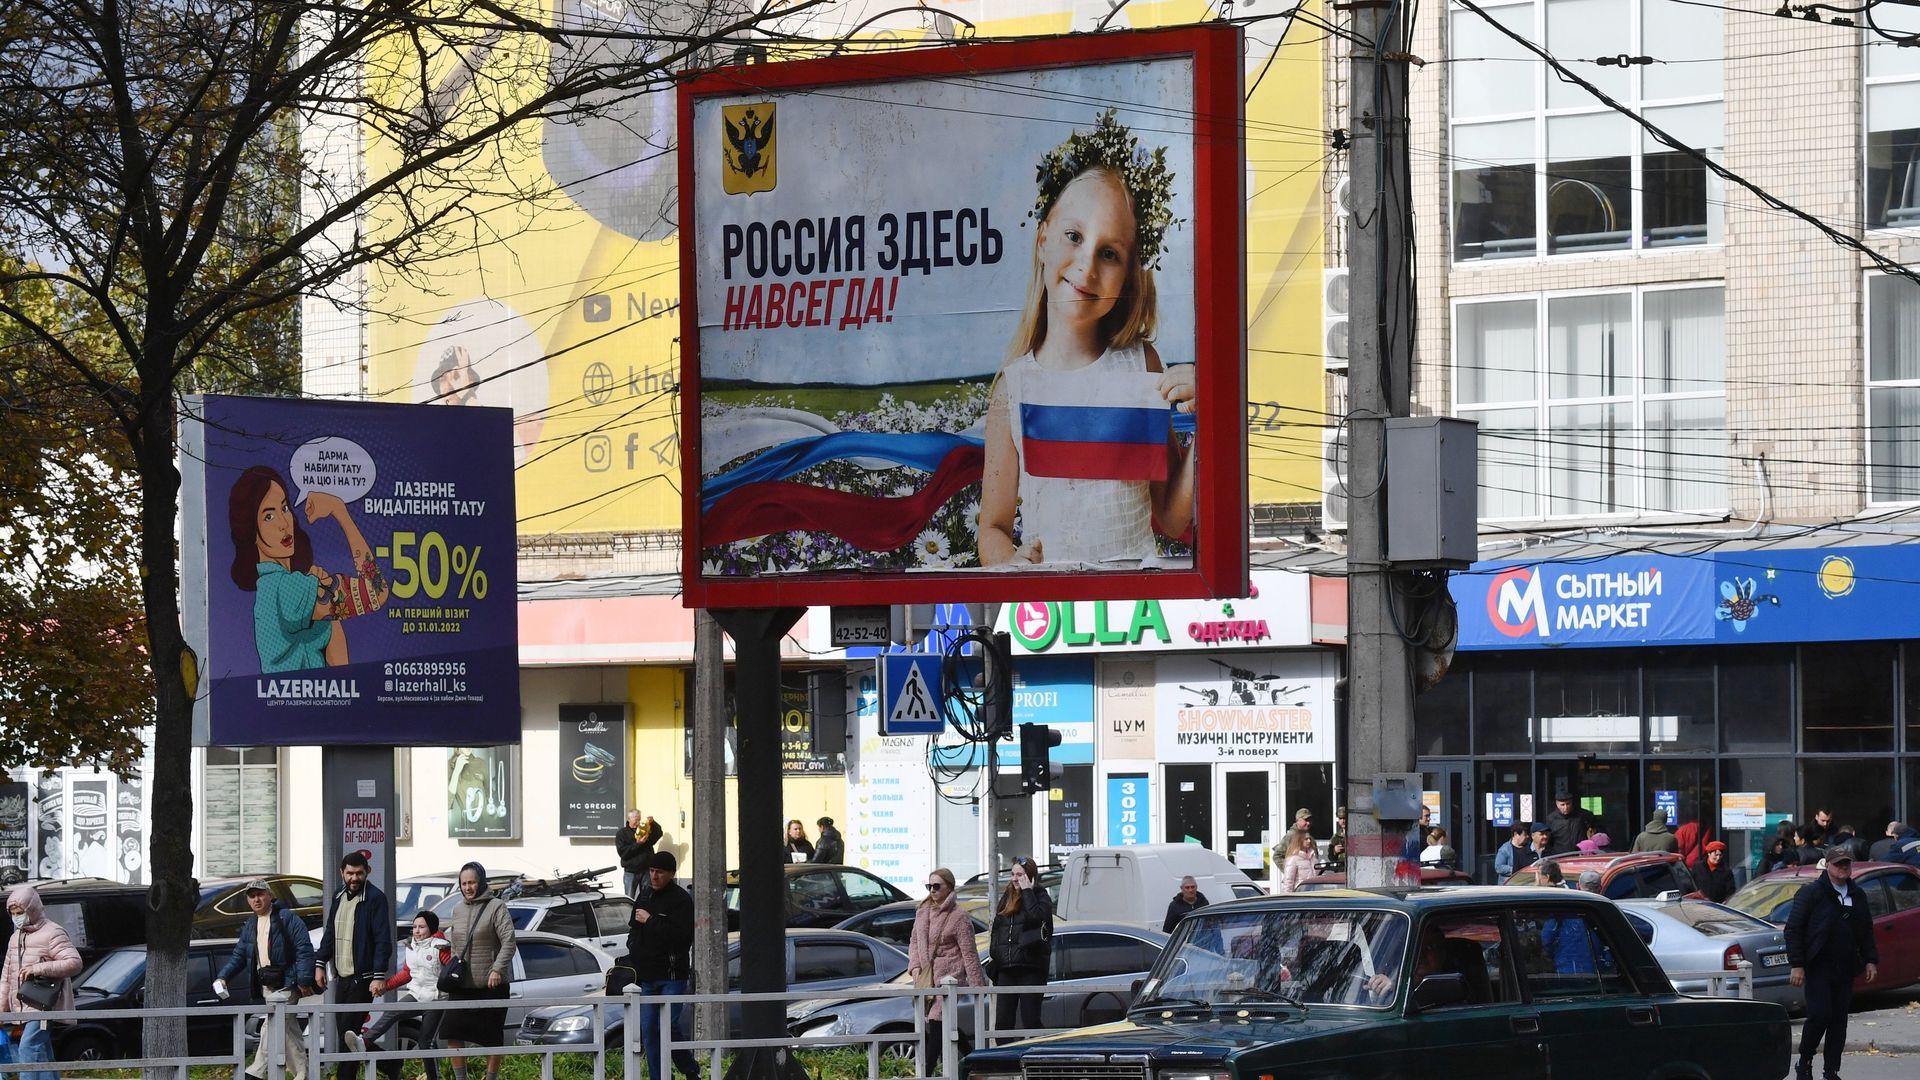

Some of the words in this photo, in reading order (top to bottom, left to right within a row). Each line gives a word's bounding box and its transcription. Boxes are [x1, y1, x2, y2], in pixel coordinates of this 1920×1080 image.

[723, 215, 865, 280] РОССИЯ
[877, 207, 1003, 276] ЗДЕСЬ
[723, 276, 899, 331] НАВСЕГДА!
[318, 451, 349, 461] ДАРМА
[304, 463, 340, 473] НАБИЛИ
[341, 464, 361, 474] ТАТУ
[303, 475, 315, 485] НА
[317, 476, 332, 486] ЦЮ
[338, 477, 350, 486] НА
[351, 477, 366, 487] ТУ?
[394, 481, 456, 498] ЛАЗЕРНЕ
[364, 499, 449, 517] ВИДАЛЕННЯ
[452, 501, 486, 516] ТАТУ
[376, 531, 488, 600] -50%
[1556, 567, 1662, 599] СЫТНЫЙ
[388, 608, 402, 618] НА
[405, 606, 442, 618] ПЕРШИЙ
[445, 608, 470, 618] ВІЗИТ
[1556, 602, 1652, 630] МАРКЕТ
[402, 623, 416, 633] ДО
[418, 622, 461, 632] 31.01.2022
[836, 627, 887, 640] 42-52-40
[1188, 620, 1271, 644] ОДЕЖДА
[394, 662, 467, 676] 0663895956
[257, 679, 360, 698] LAZERHALL
[395, 678, 467, 693] lazerhall_ks
[1014, 691, 1058, 707] PROFI
[1113, 720, 1145, 734] ЦУМ
[1177, 709, 1313, 732] SHOWMASTER
[882, 737, 916, 747] MAGNAT
[1177, 732, 1228, 745] МУЗИЧНІ
[1231, 731, 1313, 744] ІНСТРУМЕНТИ
[1217, 746, 1235, 756] 3-й
[1238, 747, 1279, 757] поверх
[345, 812, 383, 829] АРЕНДА
[345, 830, 385, 844] БІГ-БОРДІВ
